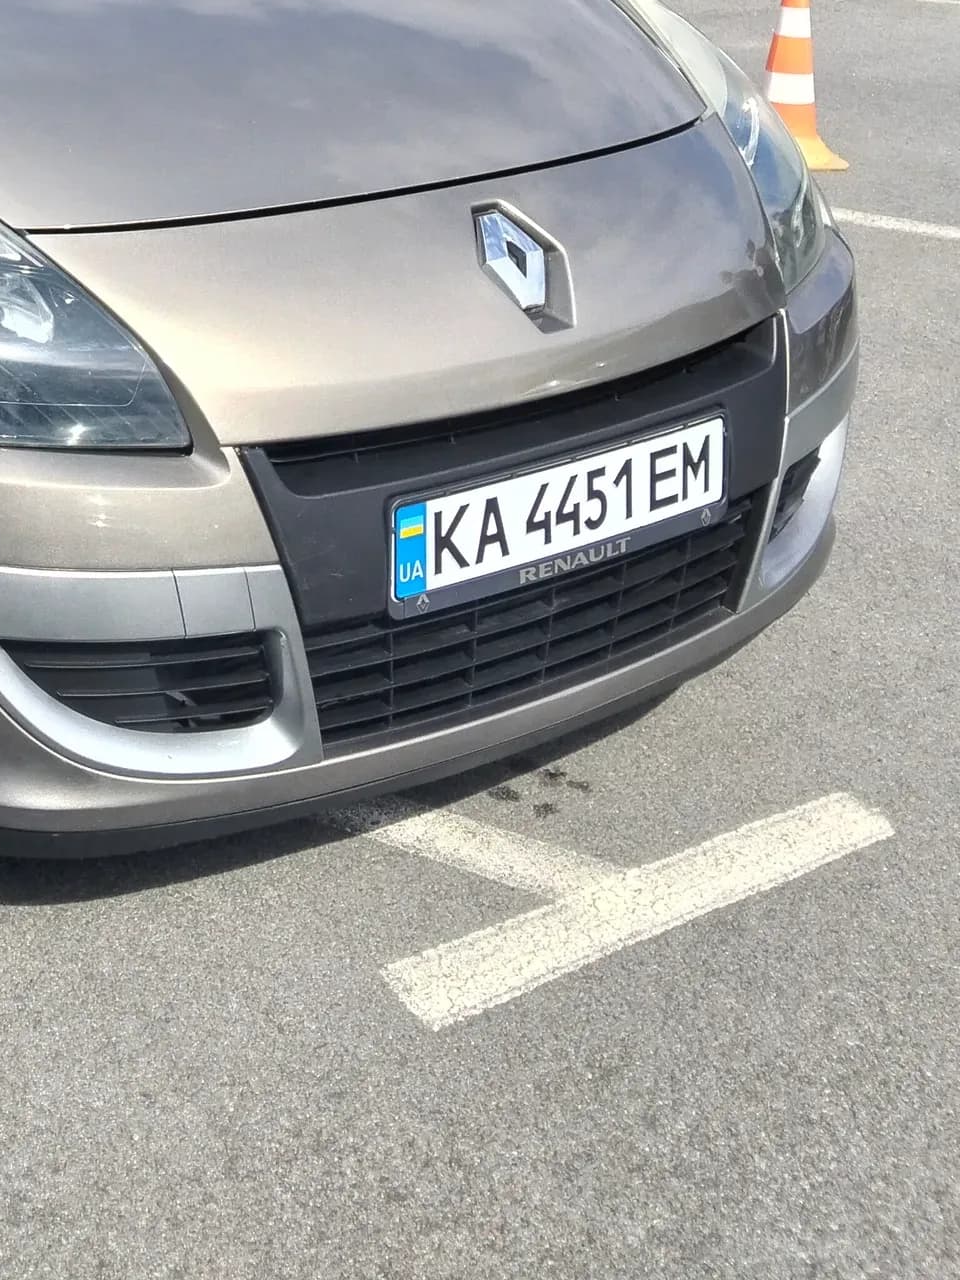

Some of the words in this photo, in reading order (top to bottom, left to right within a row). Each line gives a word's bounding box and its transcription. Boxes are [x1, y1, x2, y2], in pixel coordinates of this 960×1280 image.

[433, 497, 510, 575] KA
[525, 458, 633, 545] 4451
[649, 434, 710, 512] EM
[399, 560, 424, 583] UA
[519, 536, 631, 584] RENAULT
